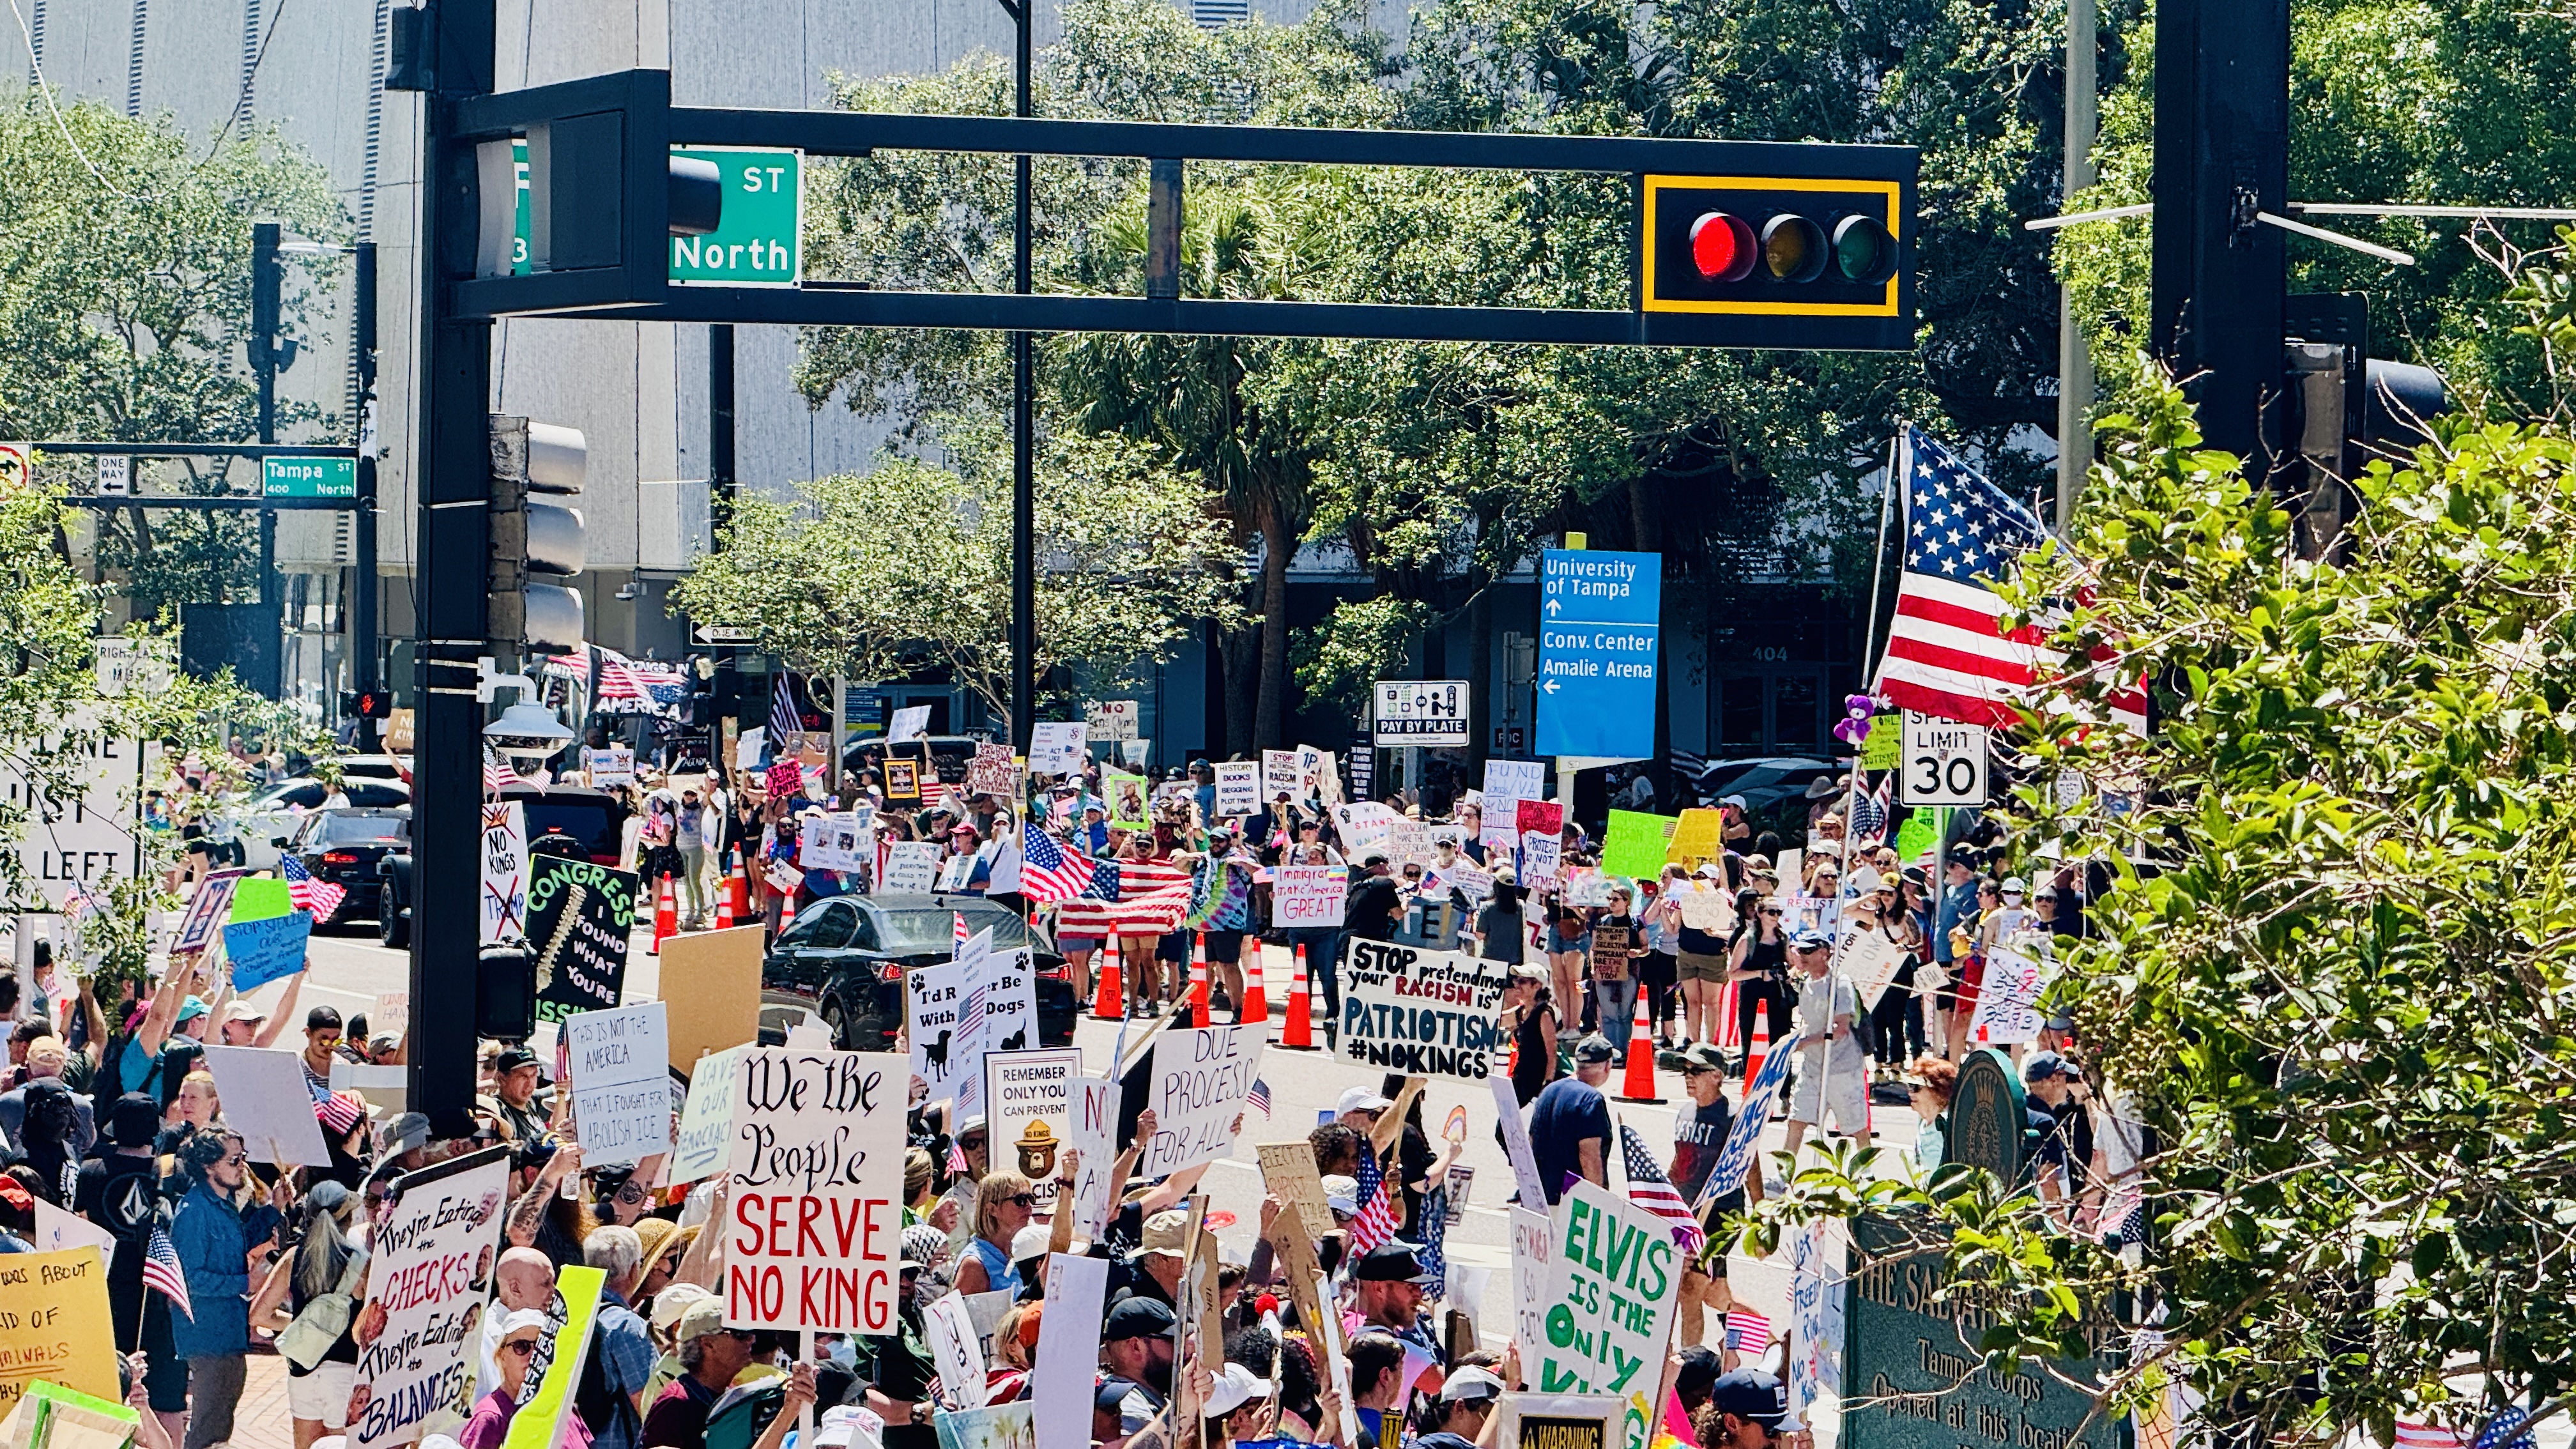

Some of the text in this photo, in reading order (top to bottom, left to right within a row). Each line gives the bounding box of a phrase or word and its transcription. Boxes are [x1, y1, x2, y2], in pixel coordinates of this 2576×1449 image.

[743, 167, 785, 192] ST
[674, 236, 788, 271] North
[101, 458, 125, 468] ONE
[101, 470, 125, 479] WAY
[267, 462, 351, 481] Tampa ST
[267, 484, 353, 495] 400 North
[1547, 558, 1636, 582] University
[1546, 579, 1630, 601] of Tampa
[1544, 632, 1654, 652] Conv. Center
[601, 650, 689, 675] NO KINGS IN
[1753, 647, 1788, 662] 404
[1543, 659, 1653, 678] Amalie Arena
[595, 696, 682, 721] AMERICA
[1102, 703, 1124, 714] NO
[1381, 720, 1463, 733] PAY BY PLATE
[1917, 732, 1968, 749] LIMIT
[1273, 753, 1293, 762] STOP
[1864, 752, 1901, 765] BUTTERFL
[772, 773, 800, 788] PEOPLE
[1223, 774, 1250, 782] BOOKS
[1269, 772, 1296, 783] RACISM
[1487, 762, 1542, 779] FUND
[1912, 756, 1976, 796] 30
[770, 781, 799, 797] UNITE
[1363, 805, 1379, 813] WE
[1498, 799, 1515, 811] NO
[1354, 818, 1394, 830] STAND
[488, 830, 507, 855] NO
[1528, 836, 1560, 856] PROTEST
[43, 850, 118, 881] LEFT
[488, 852, 516, 875] KINGS
[1531, 863, 1538, 874] A
[1535, 854, 1554, 865] NOT
[528, 862, 635, 927] CONGRESS
[1278, 884, 1344, 896] make America
[597, 905, 604, 919] I
[1284, 896, 1339, 919] GREAT
[1705, 908, 1720, 919] NO
[1787, 898, 1835, 910] RESIST
[229, 921, 261, 937] STOP
[575, 914, 627, 954] FOUND
[259, 933, 283, 949] OUR
[1841, 933, 1858, 953] FOR
[574, 940, 617, 976] WHAT
[1001, 976, 1022, 990] Be
[1353, 942, 1505, 1001] STOP pretending
[567, 965, 616, 1005] YOU'RE
[1347, 970, 1493, 1009] your RACISM is
[921, 989, 942, 1005] I'd
[919, 999, 1025, 1028] With Dogs
[1344, 997, 1499, 1053] PATRIOTISM
[573, 1015, 649, 1045] THIS IS NOT THE
[1194, 1026, 1243, 1063] DUE
[585, 1043, 631, 1073] AMERICA
[1347, 1038, 1489, 1080] #NOKINGS
[700, 1057, 738, 1087] SAVE
[1003, 1066, 1066, 1082] REMEMBER
[742, 1052, 882, 1118] We the
[1003, 1084, 1066, 1100] ONLY YOU
[1164, 1057, 1254, 1119] PROCESS
[581, 1091, 666, 1116] THAT I FOUGHT FOR
[701, 1085, 730, 1116] OUR
[1004, 1103, 1067, 1117] CAN PREVENT
[587, 1116, 660, 1155] ABOLISH ICE
[1034, 1130, 1050, 1138] KINGS
[1149, 1115, 1228, 1173] FOR ALL
[733, 1123, 866, 1195] People
[1260, 1146, 1312, 1169] ELECT A
[433, 1196, 482, 1234] Eating
[735, 1193, 890, 1261] SERVE
[417, 1239, 435, 1253] the
[1564, 1196, 1672, 1302] ELVIS
[42, 1260, 92, 1285] ABOUT
[383, 1252, 470, 1313] CHECKS
[1857, 1259, 1899, 1307] THE
[730, 1264, 888, 1330] NO KING
[1567, 1273, 1657, 1339] IS THE
[31, 1306, 59, 1329] OF
[422, 1312, 468, 1357] Eating
[407, 1356, 423, 1372] the
[1917, 1337, 2043, 1407] Tampa Corps
[358, 1361, 466, 1445] BALANCES
[1873, 1372, 2009, 1442] Opened at this
[1538, 1425, 1598, 1449] WARNING
